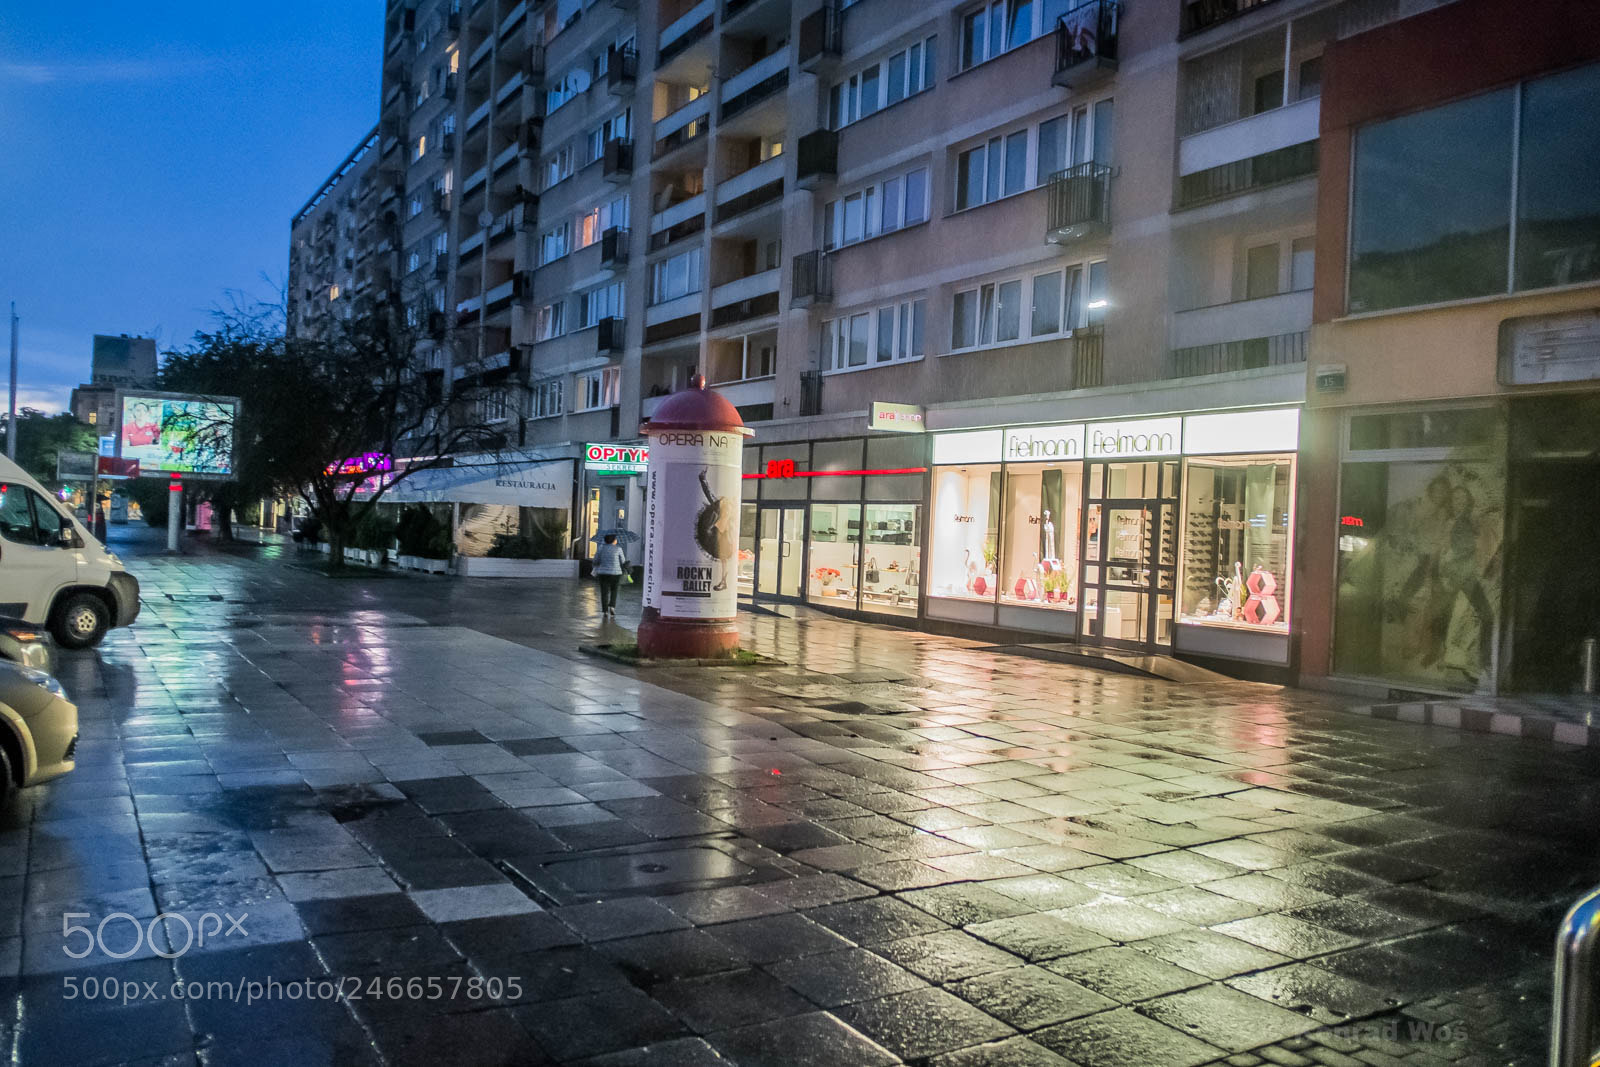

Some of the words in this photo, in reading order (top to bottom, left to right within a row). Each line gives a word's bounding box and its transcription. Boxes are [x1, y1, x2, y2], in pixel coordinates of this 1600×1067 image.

[659, 433, 703, 447] OPERA
[709, 435, 729, 448] NA
[1009, 434, 1077, 458] fielmann
[1093, 429, 1173, 454] fielmann
[767, 458, 795, 479] ara
[646, 470, 657, 606] www.opera.szczecin.p
[677, 566, 712, 580] ROCK'N
[683, 580, 711, 592] BALLET
